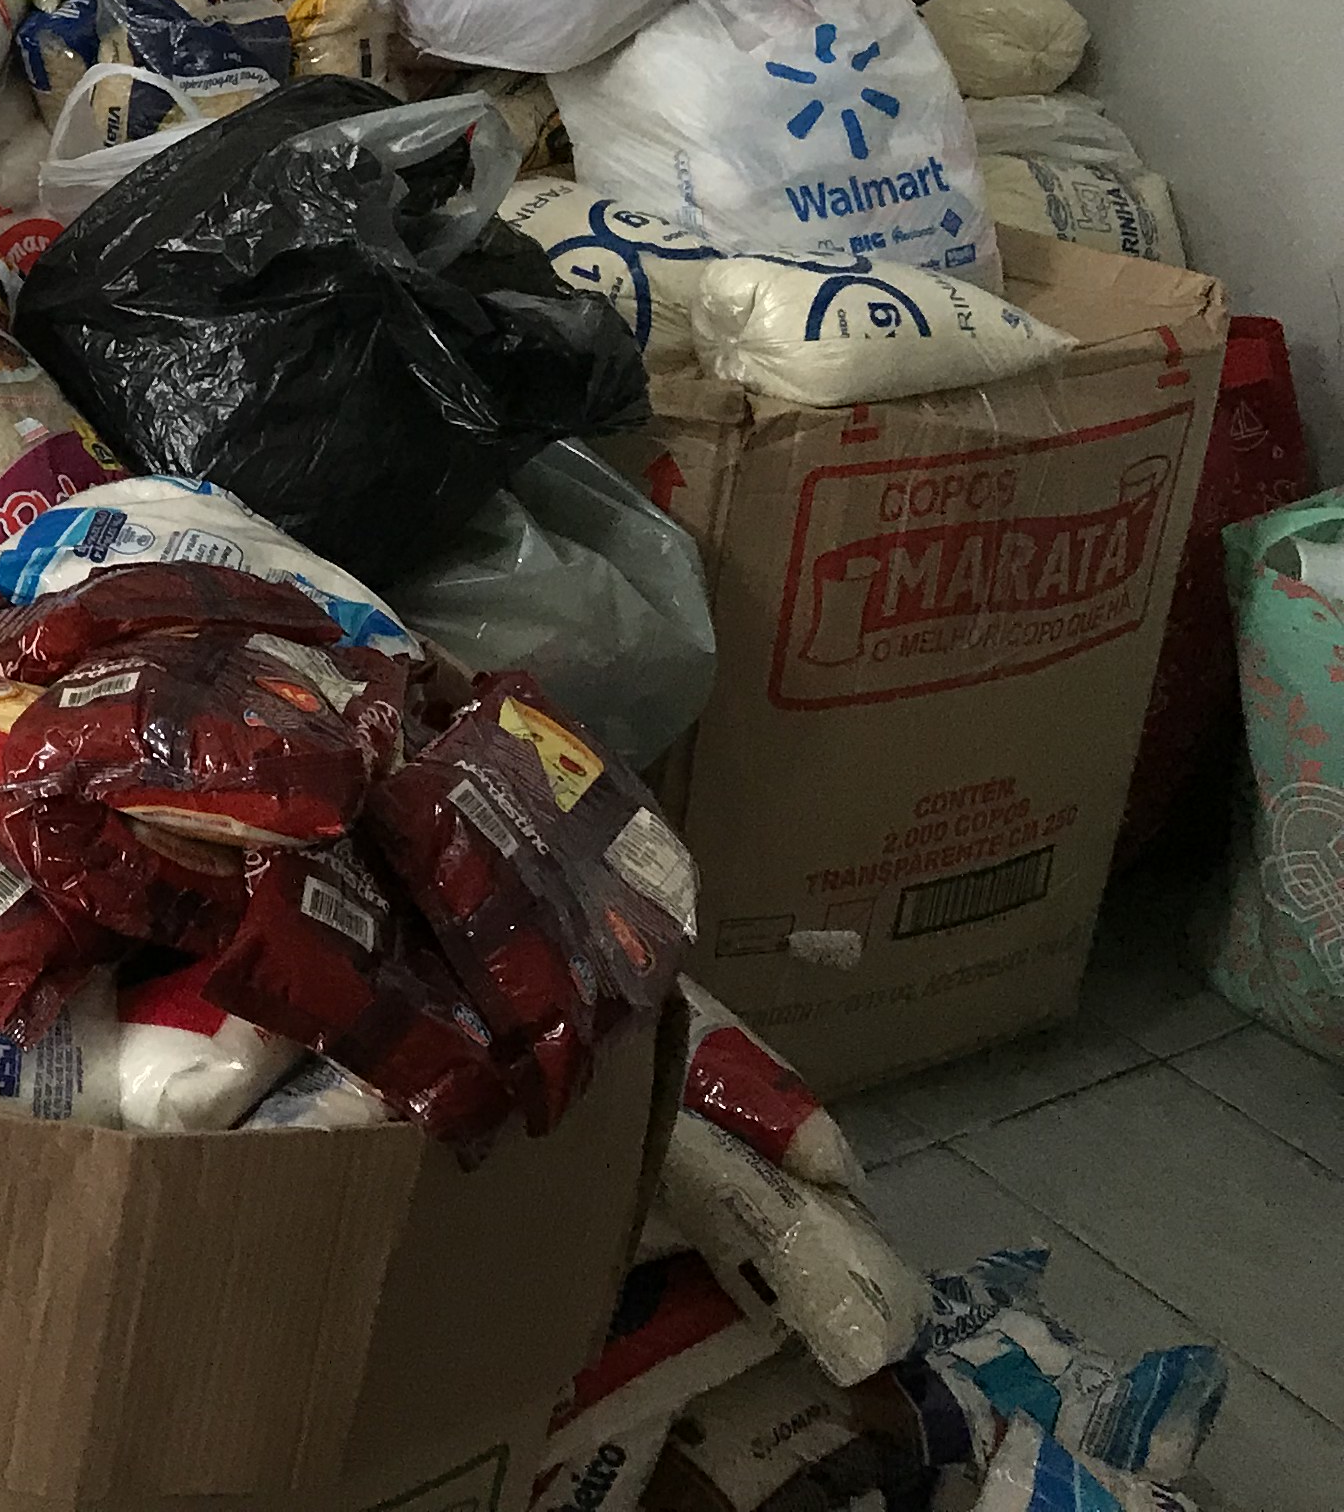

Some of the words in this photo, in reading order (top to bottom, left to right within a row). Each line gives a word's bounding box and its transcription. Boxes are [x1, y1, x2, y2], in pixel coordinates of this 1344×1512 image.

[514, 186, 572, 233] FARIN
[785, 157, 951, 223] Walmart
[850, 229, 886, 253] BIG
[879, 469, 1020, 522] COPOS
[871, 639, 892, 662] O
[1008, 620, 1063, 648] COPO
[1065, 605, 1106, 639] QUE
[954, 799, 1031, 837] COPOS
